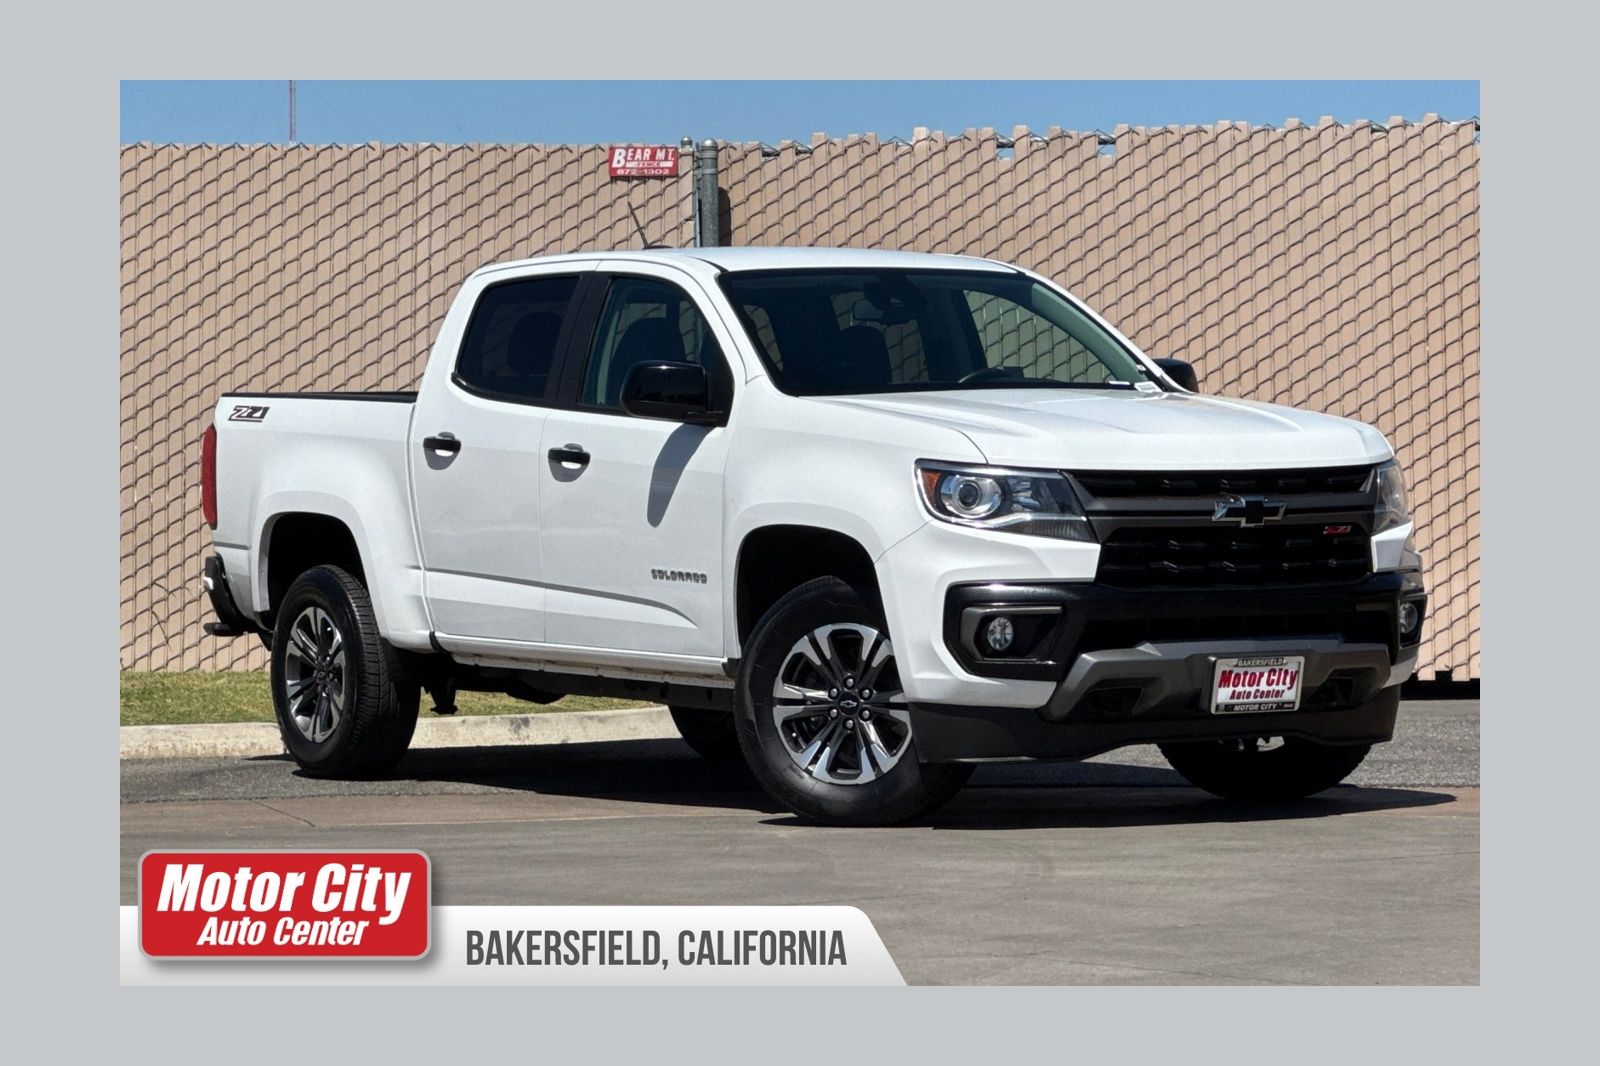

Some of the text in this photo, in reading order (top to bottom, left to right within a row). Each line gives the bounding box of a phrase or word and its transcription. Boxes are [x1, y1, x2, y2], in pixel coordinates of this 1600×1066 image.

[612, 148, 651, 168] BEAR
[651, 569, 707, 584] COLORADO
[1237, 659, 1283, 667] BAKERSFIELD
[1218, 667, 1299, 690] Motor City
[1229, 688, 1285, 700] Auto Center
[1233, 703, 1259, 711] MOTOR
[1260, 702, 1279, 710] CITY
